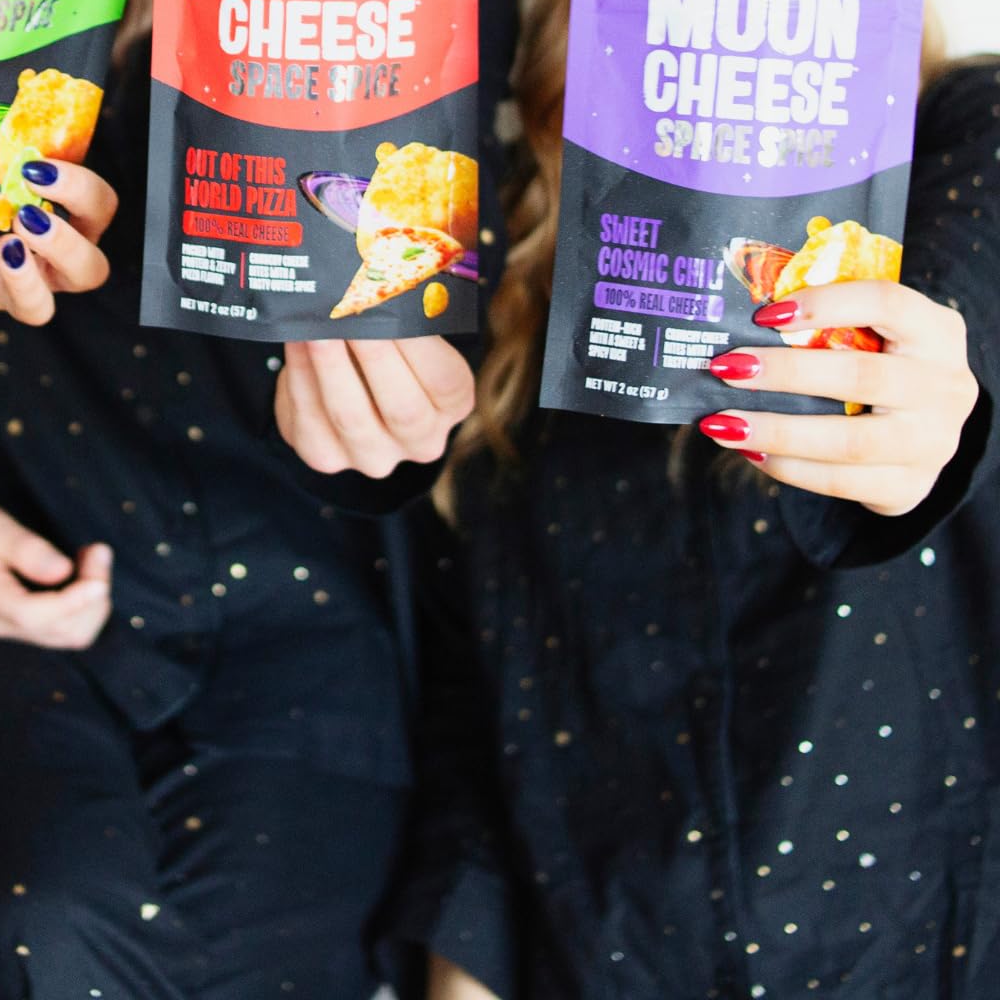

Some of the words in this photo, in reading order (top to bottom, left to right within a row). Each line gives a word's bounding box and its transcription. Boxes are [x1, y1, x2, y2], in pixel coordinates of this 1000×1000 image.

[228, 59, 320, 101] SPACE
[326, 63, 402, 103] SPICE
[643, 49, 859, 126] CHEESE
[654, 117, 753, 165] SPACE
[757, 126, 838, 169] SPICE
[186, 146, 219, 178] OUT
[219, 151, 244, 183] OF
[244, 154, 287, 187] THIS
[184, 176, 243, 214] WORLD
[245, 184, 297, 218] PIZZA
[194, 217, 224, 235] 100%
[227, 221, 250, 240] REAL
[252, 224, 290, 243] CHEESE
[600, 212, 663, 249] SWEET
[597, 245, 670, 284] COSMIC
[180, 297, 197, 311] NET
[197, 301, 210, 313] WT
[210, 302, 218, 315] 2
[217, 306, 230, 317] oz
[229, 304, 246, 319] (57
[604, 287, 636, 309] 100%
[640, 292, 665, 312] REAL
[585, 376, 602, 391] NET
[602, 379, 617, 393] WT
[617, 382, 626, 395] 2
[626, 386, 639, 397] oz
[639, 385, 656, 399] (57
[656, 387, 670, 402] g)
